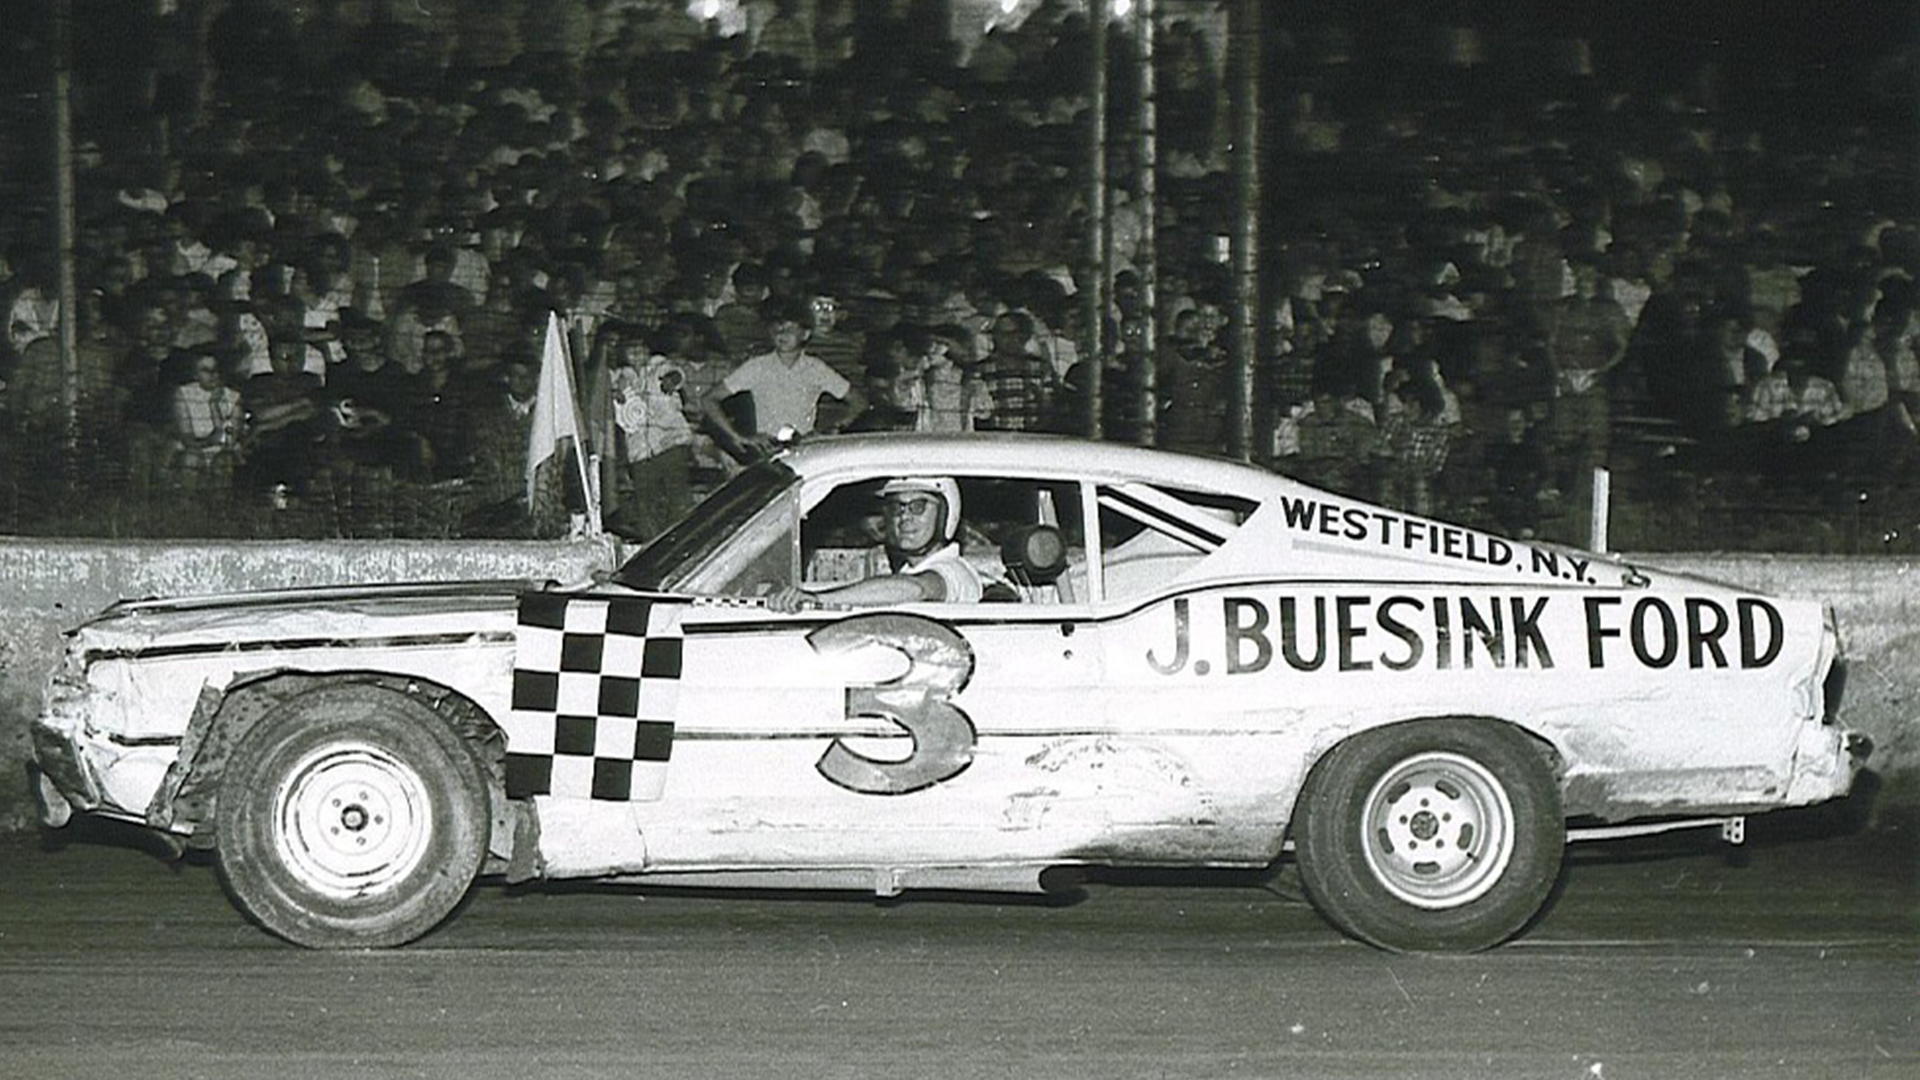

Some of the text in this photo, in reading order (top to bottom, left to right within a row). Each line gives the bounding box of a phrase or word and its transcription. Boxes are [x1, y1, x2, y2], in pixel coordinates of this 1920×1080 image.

[1223, 596, 1553, 675] BUESINK
[1583, 597, 1784, 669] FORD
[804, 611, 978, 795] 3
